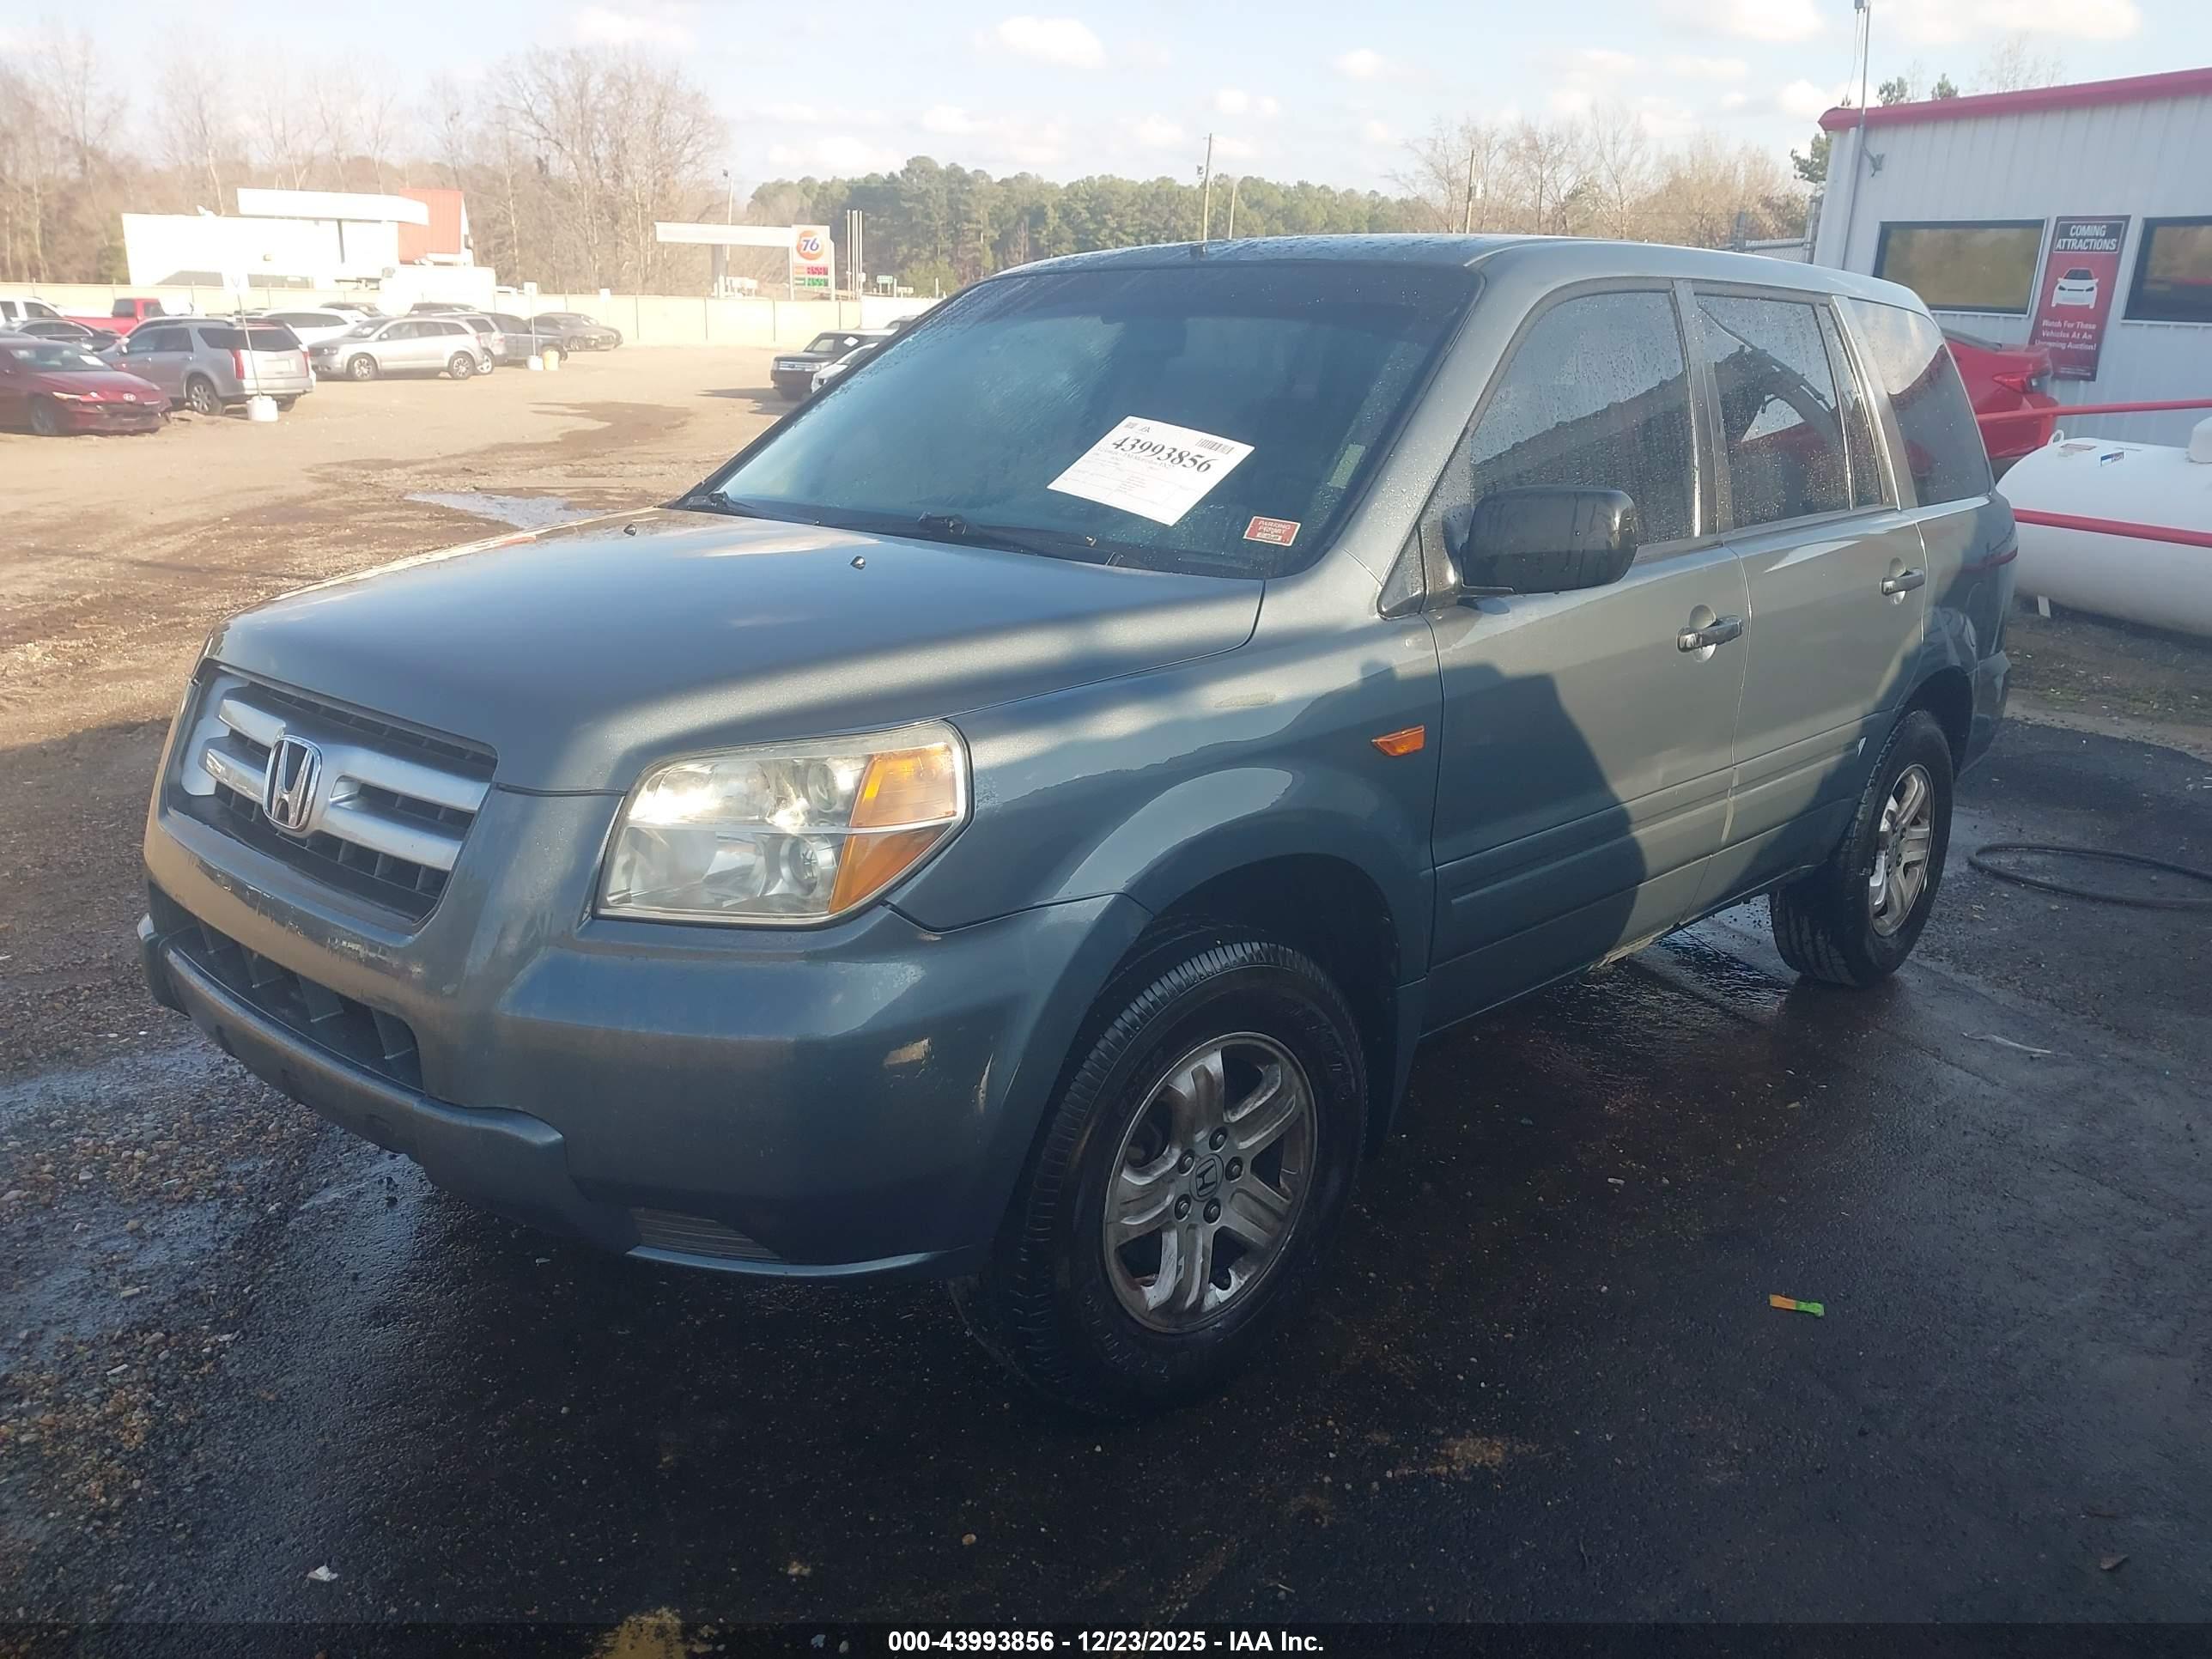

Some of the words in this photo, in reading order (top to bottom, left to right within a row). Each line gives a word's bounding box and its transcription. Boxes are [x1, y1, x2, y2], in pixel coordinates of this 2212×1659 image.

[2069, 224, 2107, 237] COMING
[803, 239, 819, 251] 76
[2056, 238, 2118, 252] ATTRACTIONS
[2063, 320, 2075, 329] For
[2042, 329, 2069, 338] Vehicles
[2071, 331, 2081, 339] At
[2081, 331, 2093, 340] An
[1112, 435, 1219, 473] 43993856
